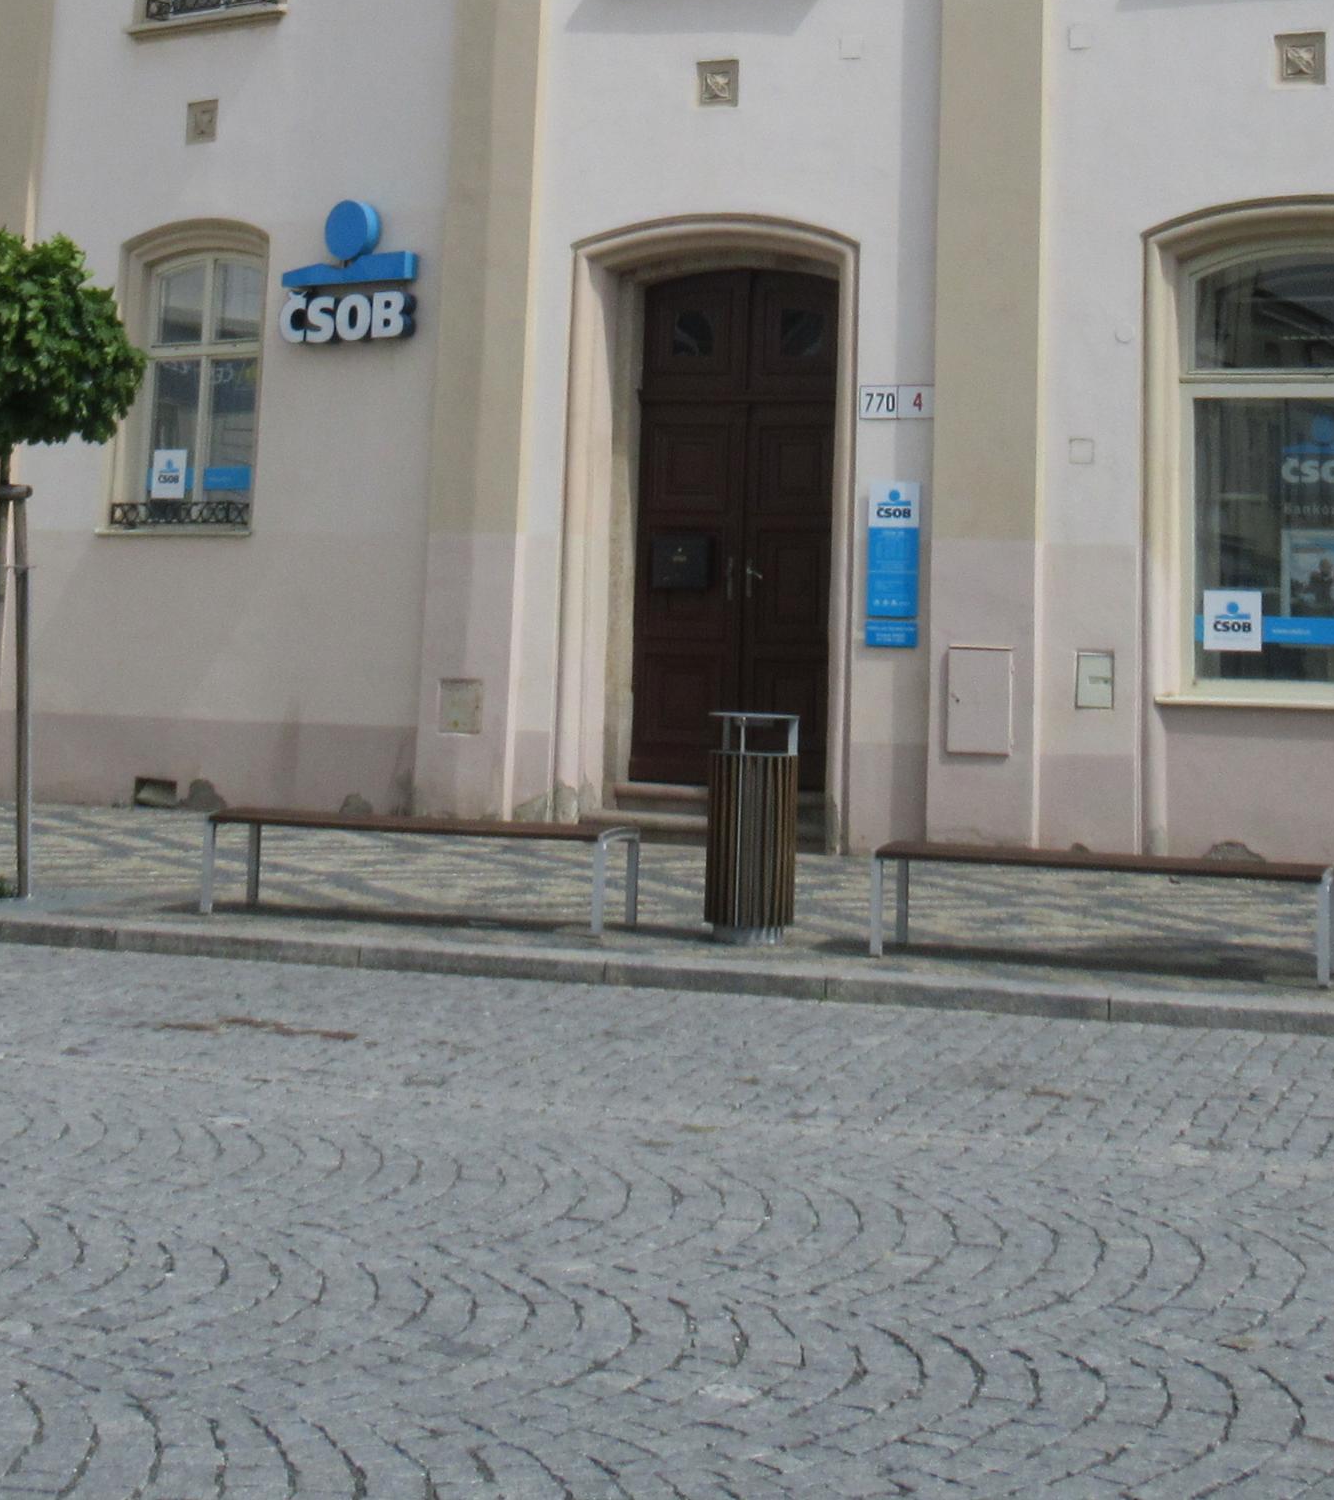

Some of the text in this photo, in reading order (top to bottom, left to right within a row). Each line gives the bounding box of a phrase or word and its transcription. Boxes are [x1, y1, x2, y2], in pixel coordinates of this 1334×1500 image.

[279, 291, 407, 344] ČSOB
[865, 393, 895, 412] 770
[913, 392, 923, 412] 4
[876, 506, 912, 518] ČSOB
[1213, 619, 1252, 633] ČSOB
